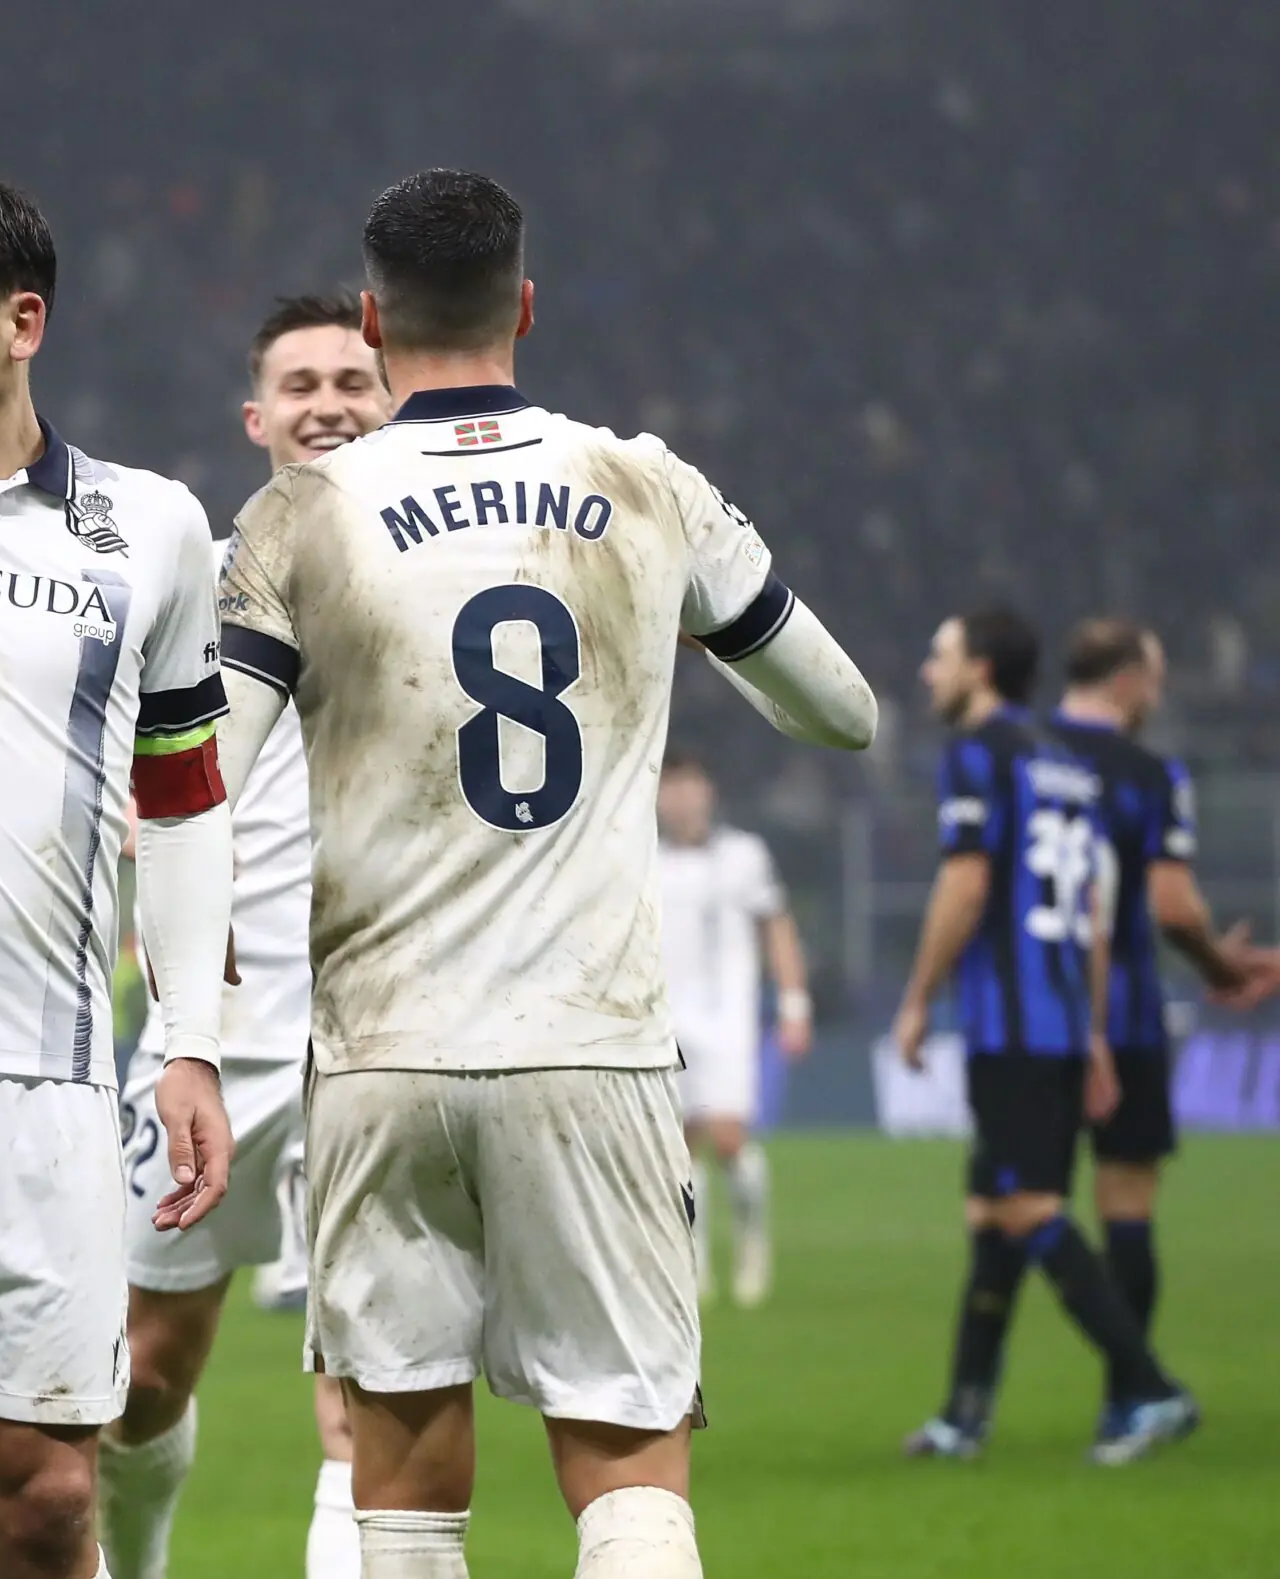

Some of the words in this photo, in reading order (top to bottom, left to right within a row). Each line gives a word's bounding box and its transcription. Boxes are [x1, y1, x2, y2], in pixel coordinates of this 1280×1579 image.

[379, 480, 612, 553] MERINO
[73, 622, 115, 646] group
[451, 584, 582, 833] 8
